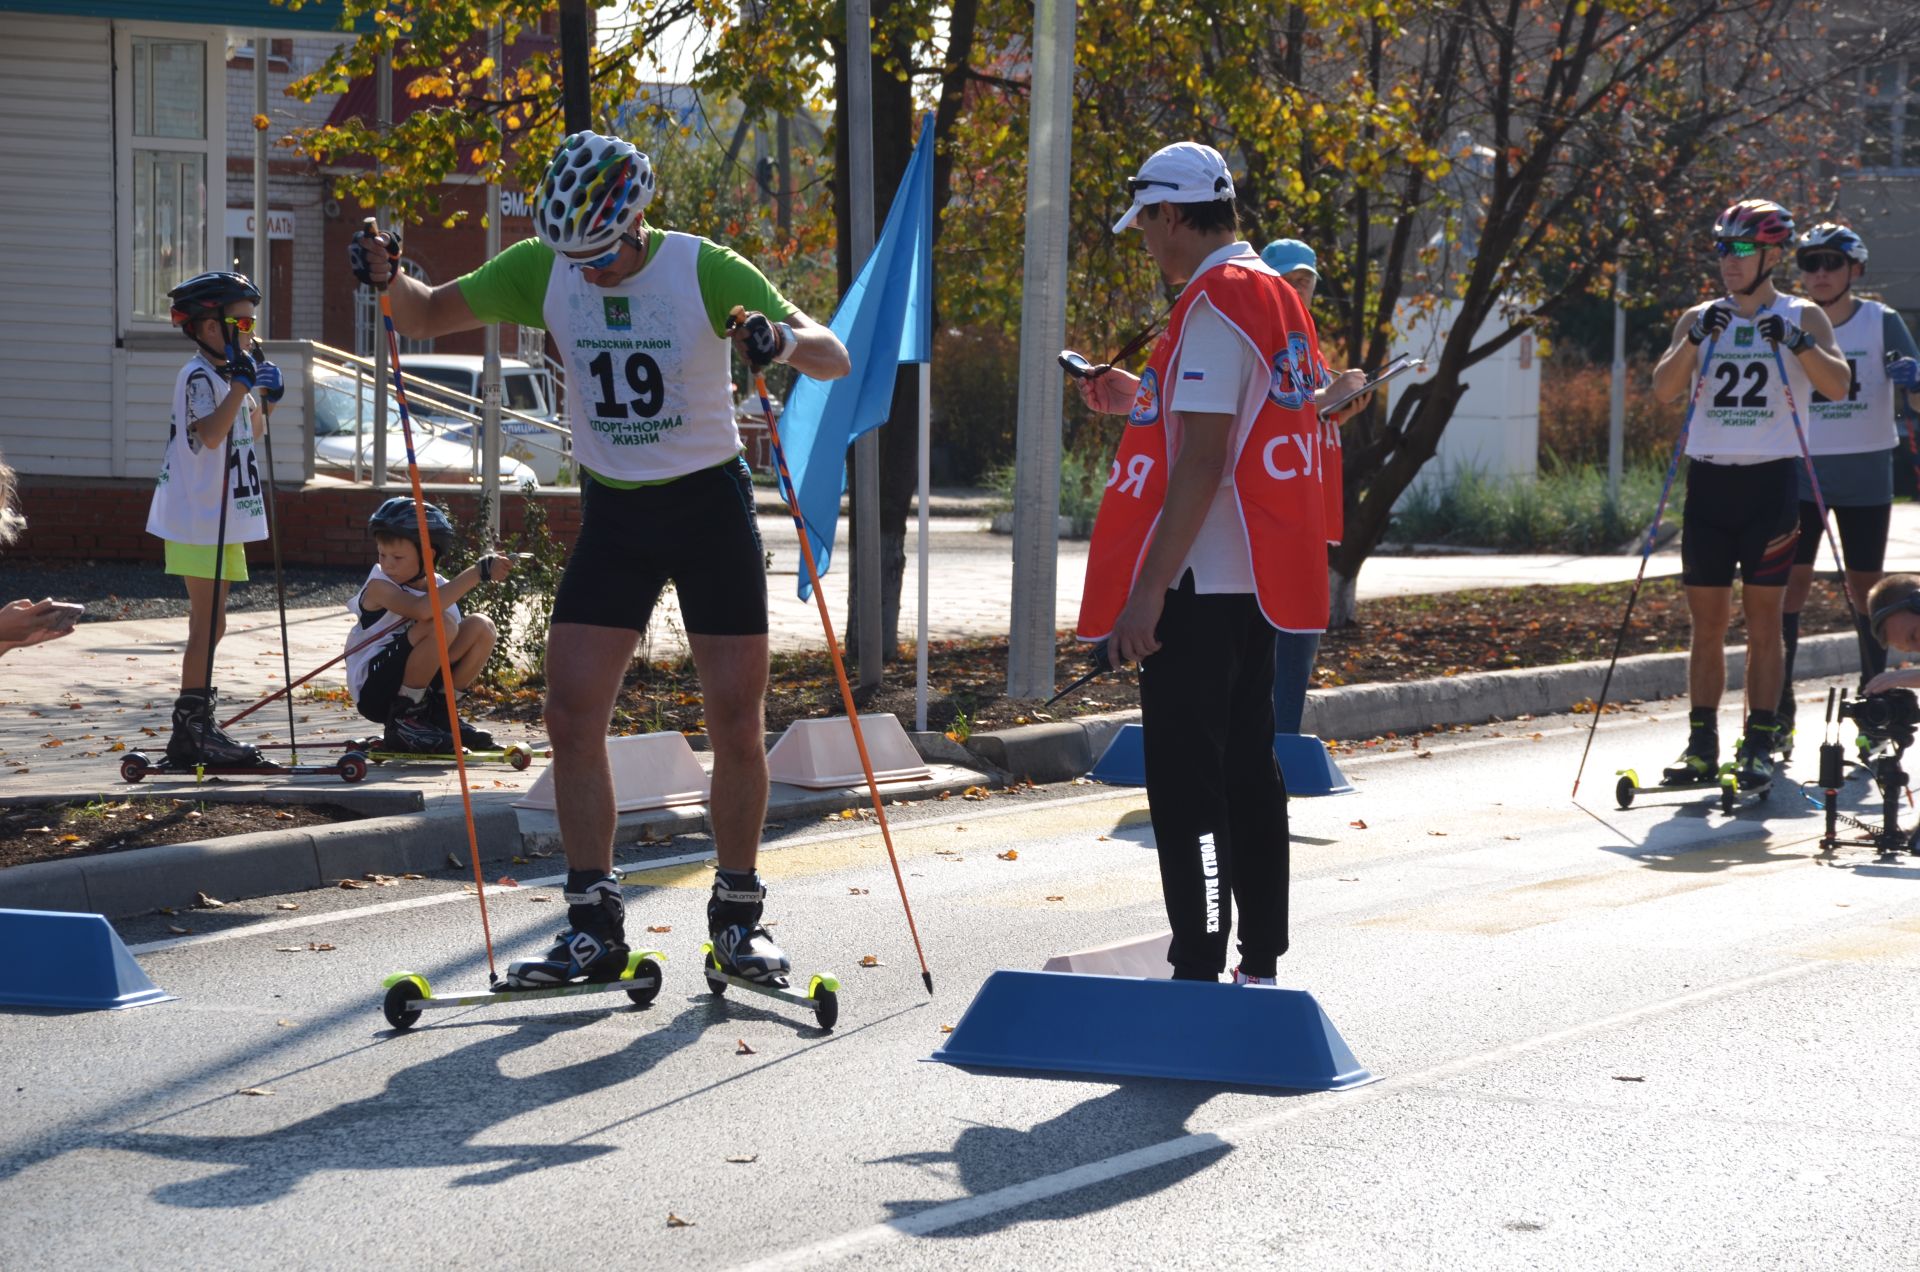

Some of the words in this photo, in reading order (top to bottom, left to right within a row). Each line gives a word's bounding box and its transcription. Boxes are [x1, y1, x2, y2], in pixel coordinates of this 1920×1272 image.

[576, 338, 633, 350] АГРЫЗСКИЙ
[635, 338, 672, 350] РАЙОН
[589, 352, 665, 419] 19
[1713, 361, 1769, 408] 22
[612, 433, 660, 446] ЖИЗНИ
[230, 448, 260, 499] 16
[1205, 877, 1219, 934] BALANCE
